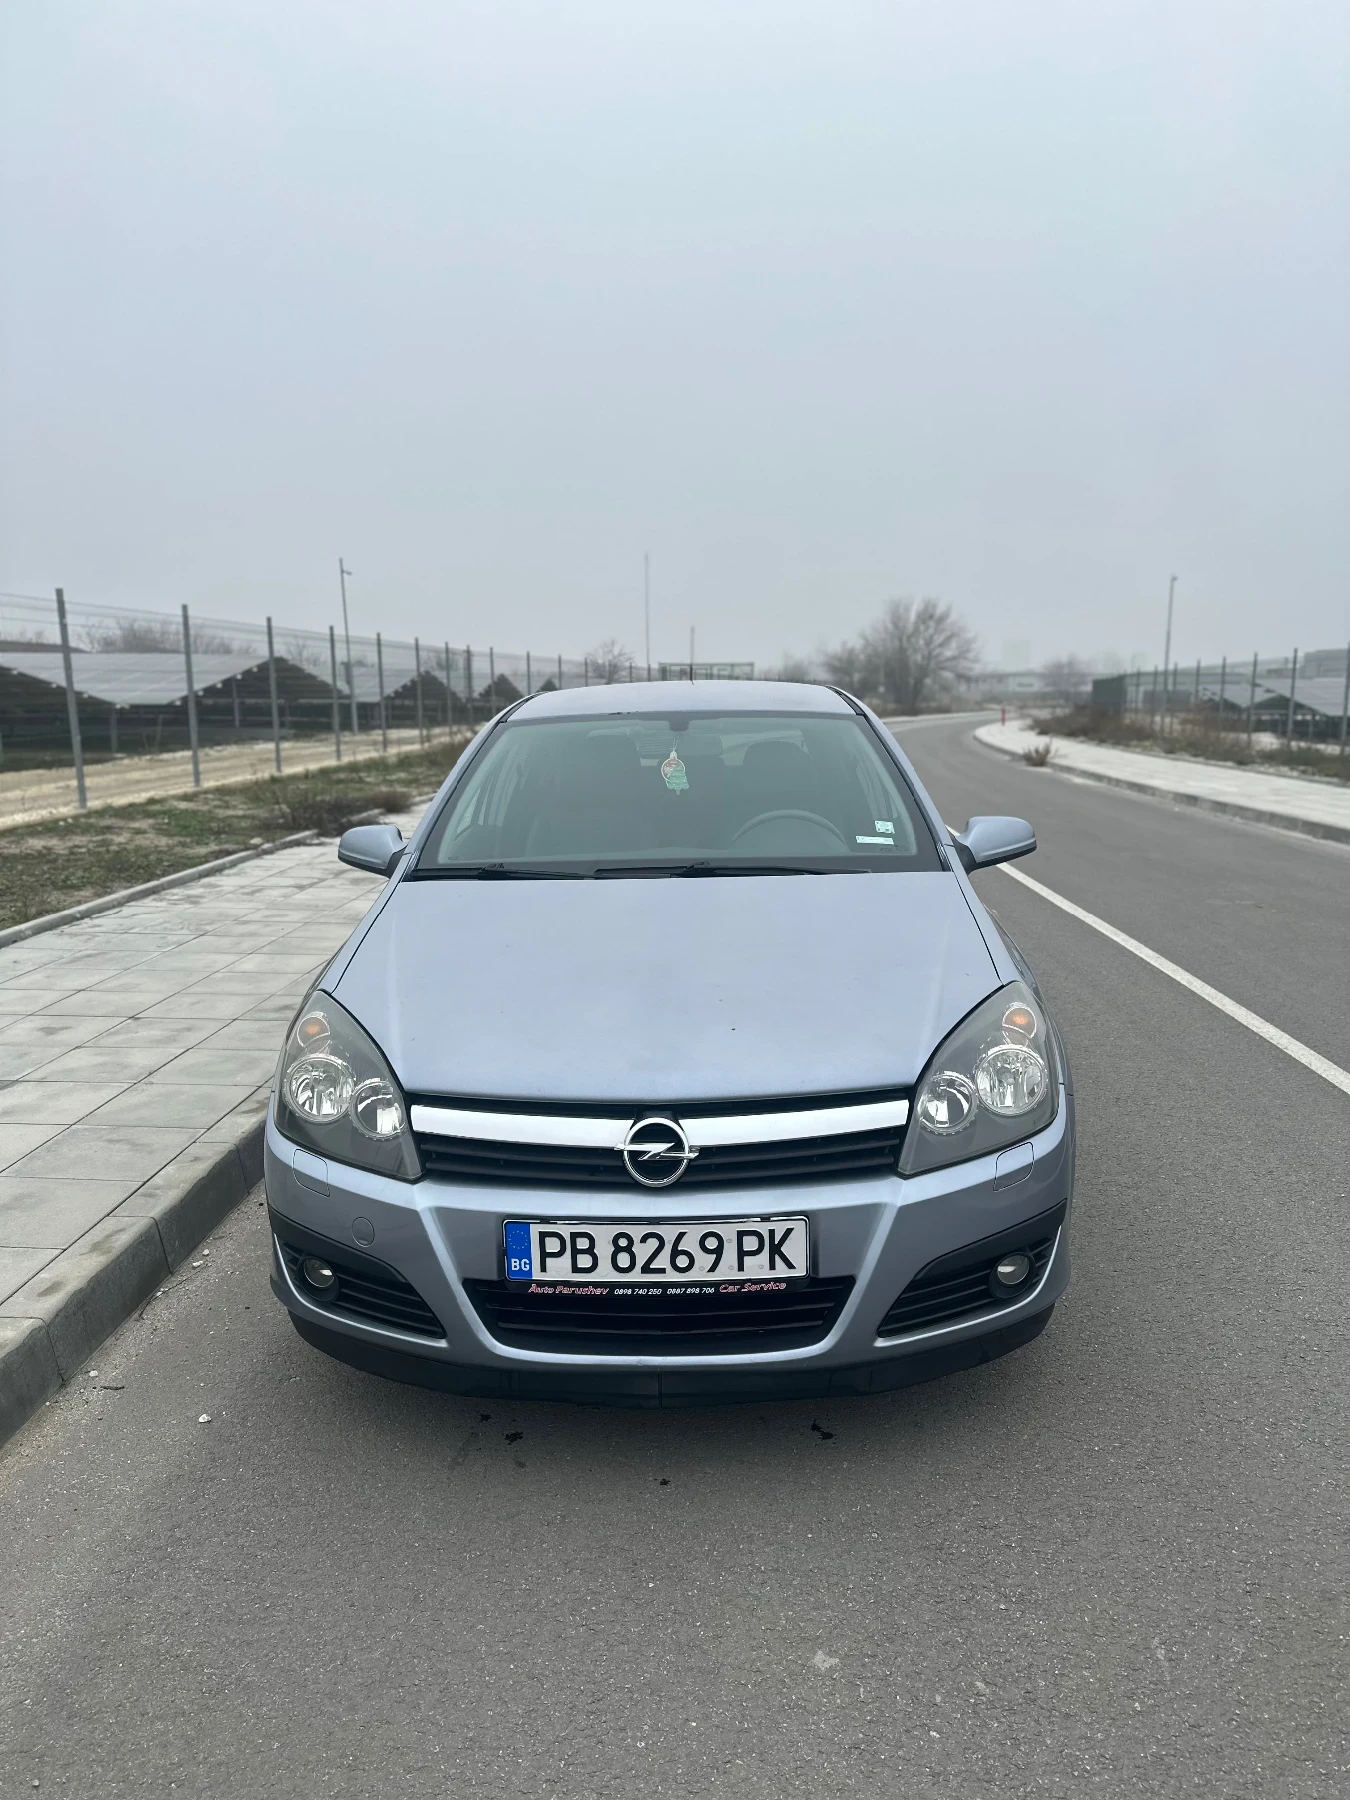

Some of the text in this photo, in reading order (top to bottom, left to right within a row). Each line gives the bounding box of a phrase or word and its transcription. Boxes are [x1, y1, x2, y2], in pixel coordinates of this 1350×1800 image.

[538, 1227, 797, 1274] PB 8269 PK
[510, 1257, 530, 1271] BG
[528, 1284, 554, 1294] Auto
[719, 1283, 740, 1293] Car
[741, 1281, 786, 1293] Service
